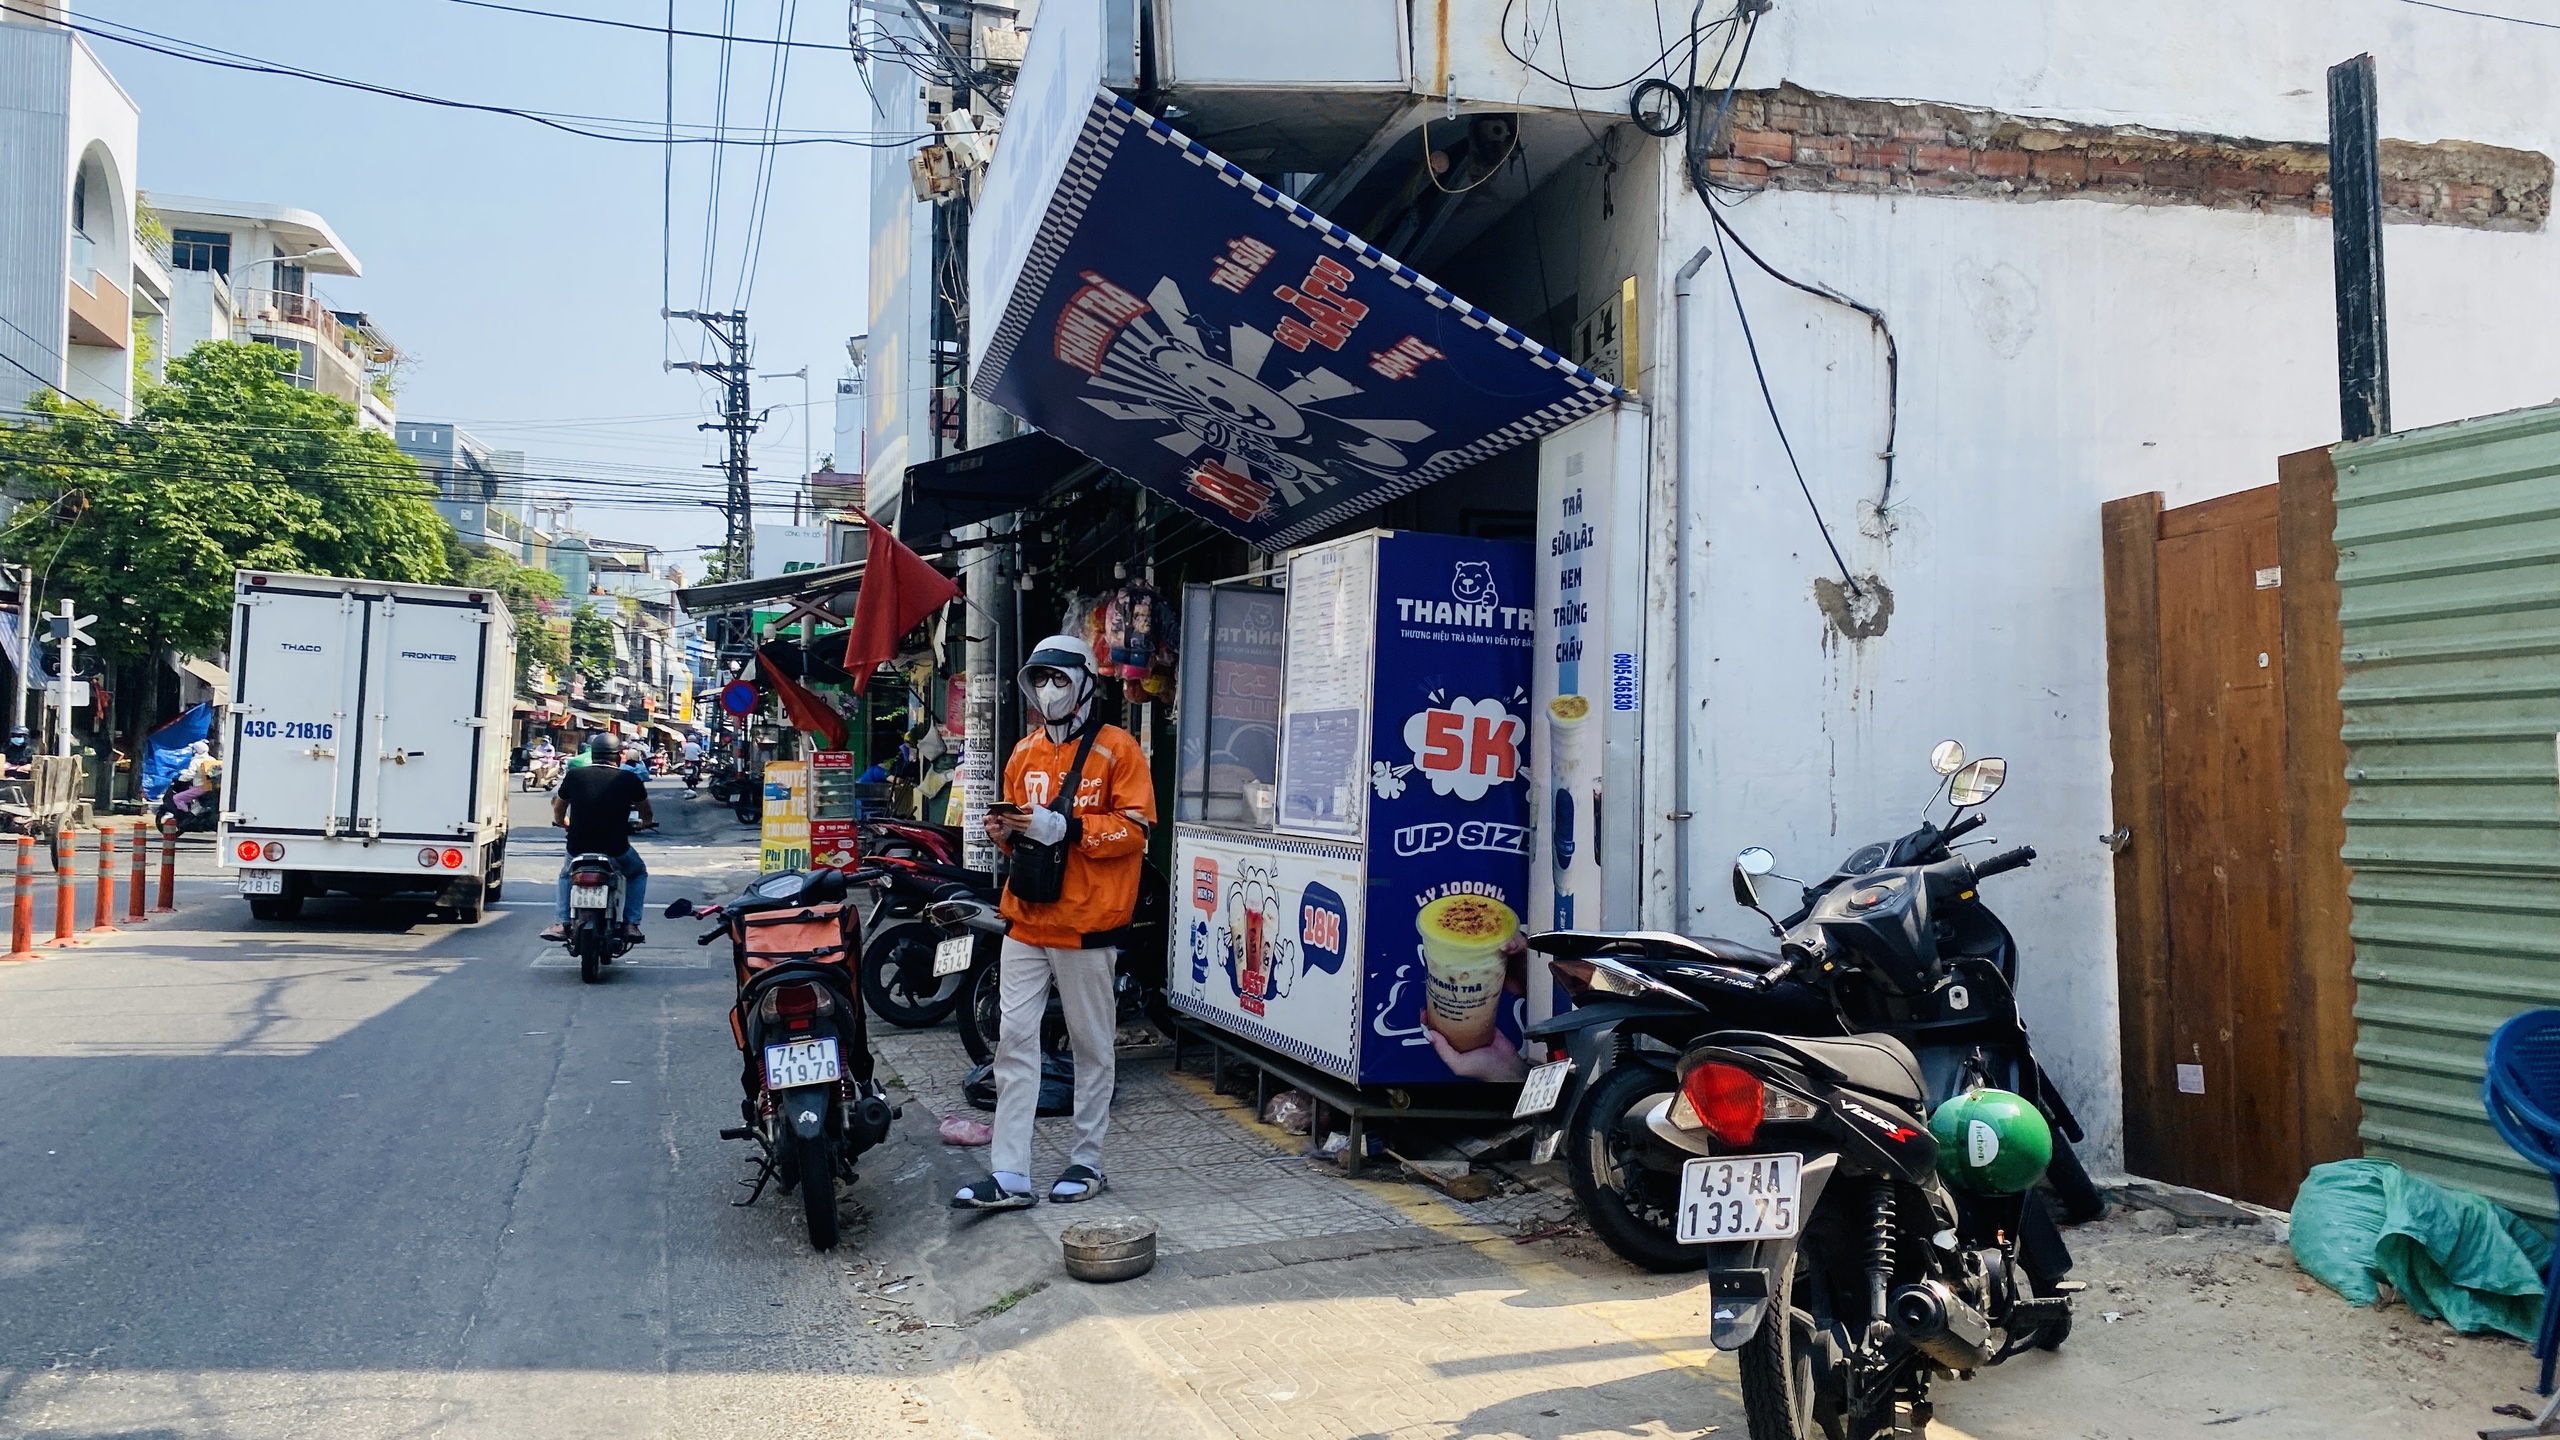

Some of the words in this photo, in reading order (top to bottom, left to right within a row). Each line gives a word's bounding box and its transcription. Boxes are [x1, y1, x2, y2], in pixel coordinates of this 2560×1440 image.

[1209, 255, 1256, 294] TRÀ
[1054, 302, 1115, 377] THANH
[1579, 303, 1617, 362] 14
[1186, 458, 1275, 523] 18K
[1563, 488, 1582, 518] TRÀ
[1551, 529, 1571, 557] SỮA
[1574, 523, 1594, 552] LÀI
[1560, 568, 1581, 591] KEM
[1397, 598, 1493, 628] THANH
[1500, 607, 1535, 631] TR
[1553, 600, 1588, 627] TRỨNG
[281, 643, 322, 652] THACO
[1401, 629, 1431, 639] THƯƠNG
[1433, 630, 1449, 642] HIỆU
[1452, 631, 1465, 641] TRÀ
[402, 651, 457, 661] FRONTIER
[1555, 640, 1583, 663] CHÁY
[244, 721, 333, 739] 43C-218.16
[1423, 711, 1516, 779] 5K
[1072, 789, 1100, 808] ood
[1394, 822, 1453, 856] UP
[765, 848, 780, 861] Phí
[239, 880, 280, 893] 218.16
[1415, 888, 1437, 907] LY
[1440, 880, 1506, 902] 1000ML
[1304, 906, 1341, 954] 18K
[777, 1042, 825, 1067] 74-C1
[772, 1061, 836, 1086] 519.78
[1700, 1161, 1781, 1197] 43-AA
[1688, 1197, 1791, 1236] 133.75
